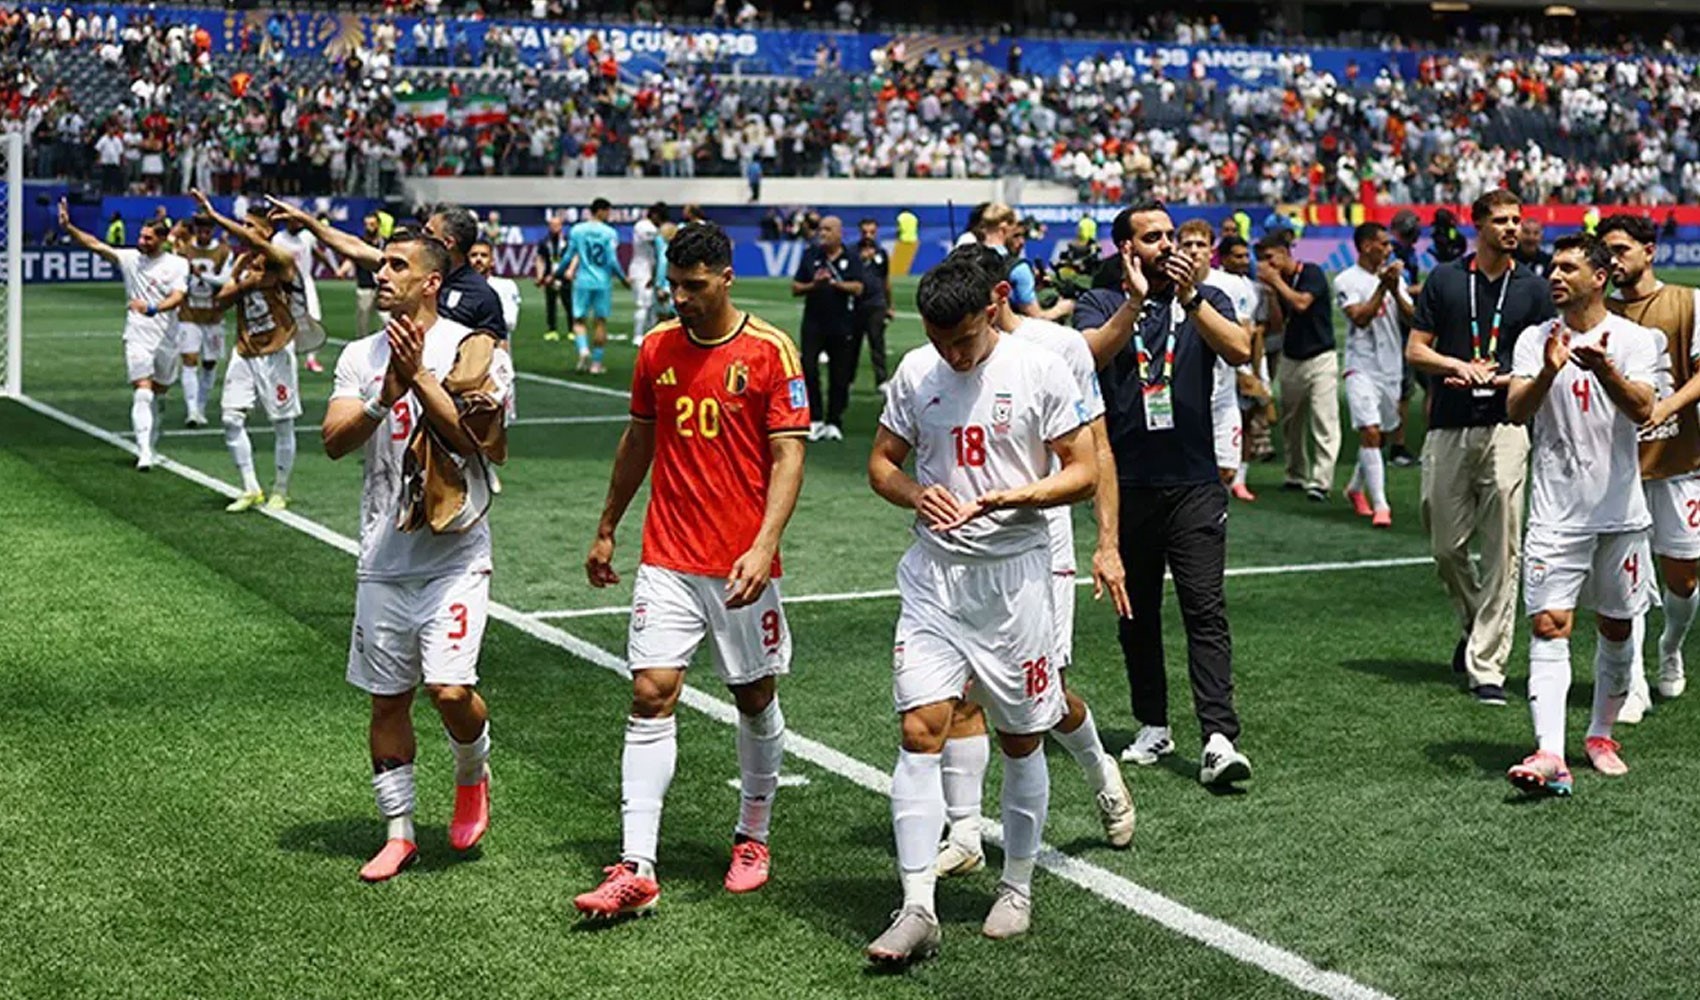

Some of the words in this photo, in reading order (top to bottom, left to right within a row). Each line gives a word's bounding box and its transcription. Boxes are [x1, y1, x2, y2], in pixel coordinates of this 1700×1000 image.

[1135, 48, 1189, 66] LOS
[1196, 50, 1313, 69] ANGEL
[276, 384, 287, 401] 8
[1572, 378, 1590, 412] 4
[391, 401, 411, 440] 3
[676, 396, 720, 438] 20
[951, 425, 986, 467] 18
[1687, 499, 1700, 527] 2
[1624, 553, 1638, 584] 4
[448, 604, 467, 638] 3
[761, 610, 780, 646] 9
[1022, 656, 1049, 697] 18
